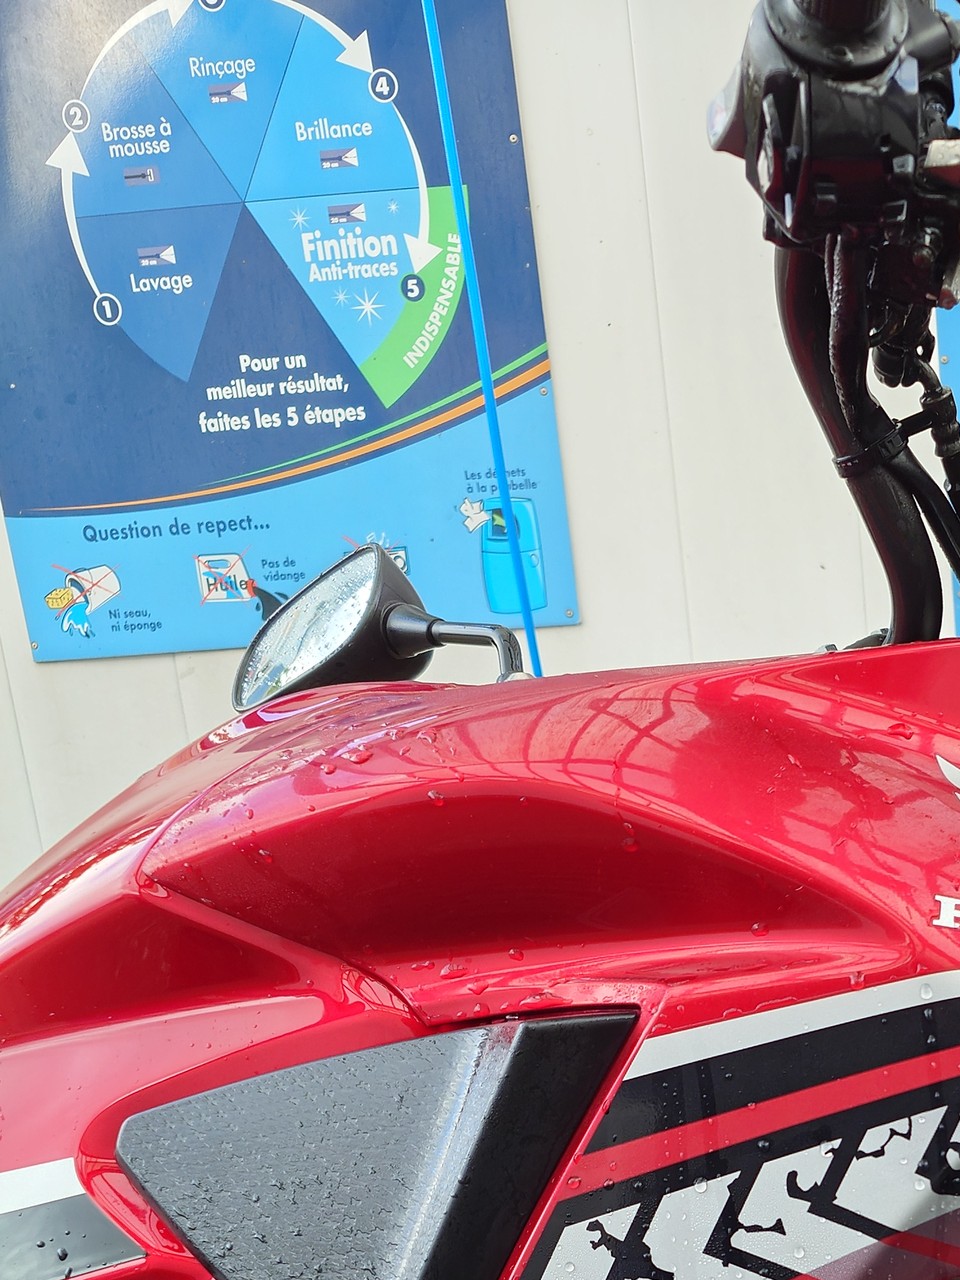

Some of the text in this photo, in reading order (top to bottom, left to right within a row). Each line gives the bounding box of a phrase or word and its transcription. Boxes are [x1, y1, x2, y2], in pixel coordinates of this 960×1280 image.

[189, 56, 256, 80] Rinçage
[375, 77, 390, 95] 4
[69, 107, 83, 126] 2
[102, 117, 173, 142] Brosse à
[295, 118, 373, 141] Brillance
[109, 139, 170, 158] mousse
[301, 226, 398, 262] Finition
[309, 260, 398, 282] Anti-traces
[129, 272, 193, 294] Lavage
[407, 279, 420, 297] 5
[102, 301, 113, 319] 1
[402, 232, 462, 369] INDISPENSABLE
[239, 354, 307, 373] Pour un
[206, 372, 349, 400] meilleur résultat,
[199, 404, 366, 433] faites les 5 étapes
[464, 470, 482, 480] Les
[476, 482, 487, 493] la
[82, 514, 271, 543] Question de repect...
[261, 557, 296, 568] Pas de
[205, 576, 248, 592] Huile
[263, 570, 306, 583] vidange
[108, 609, 152, 620] Ni seau,
[111, 620, 163, 632] ni éponge
